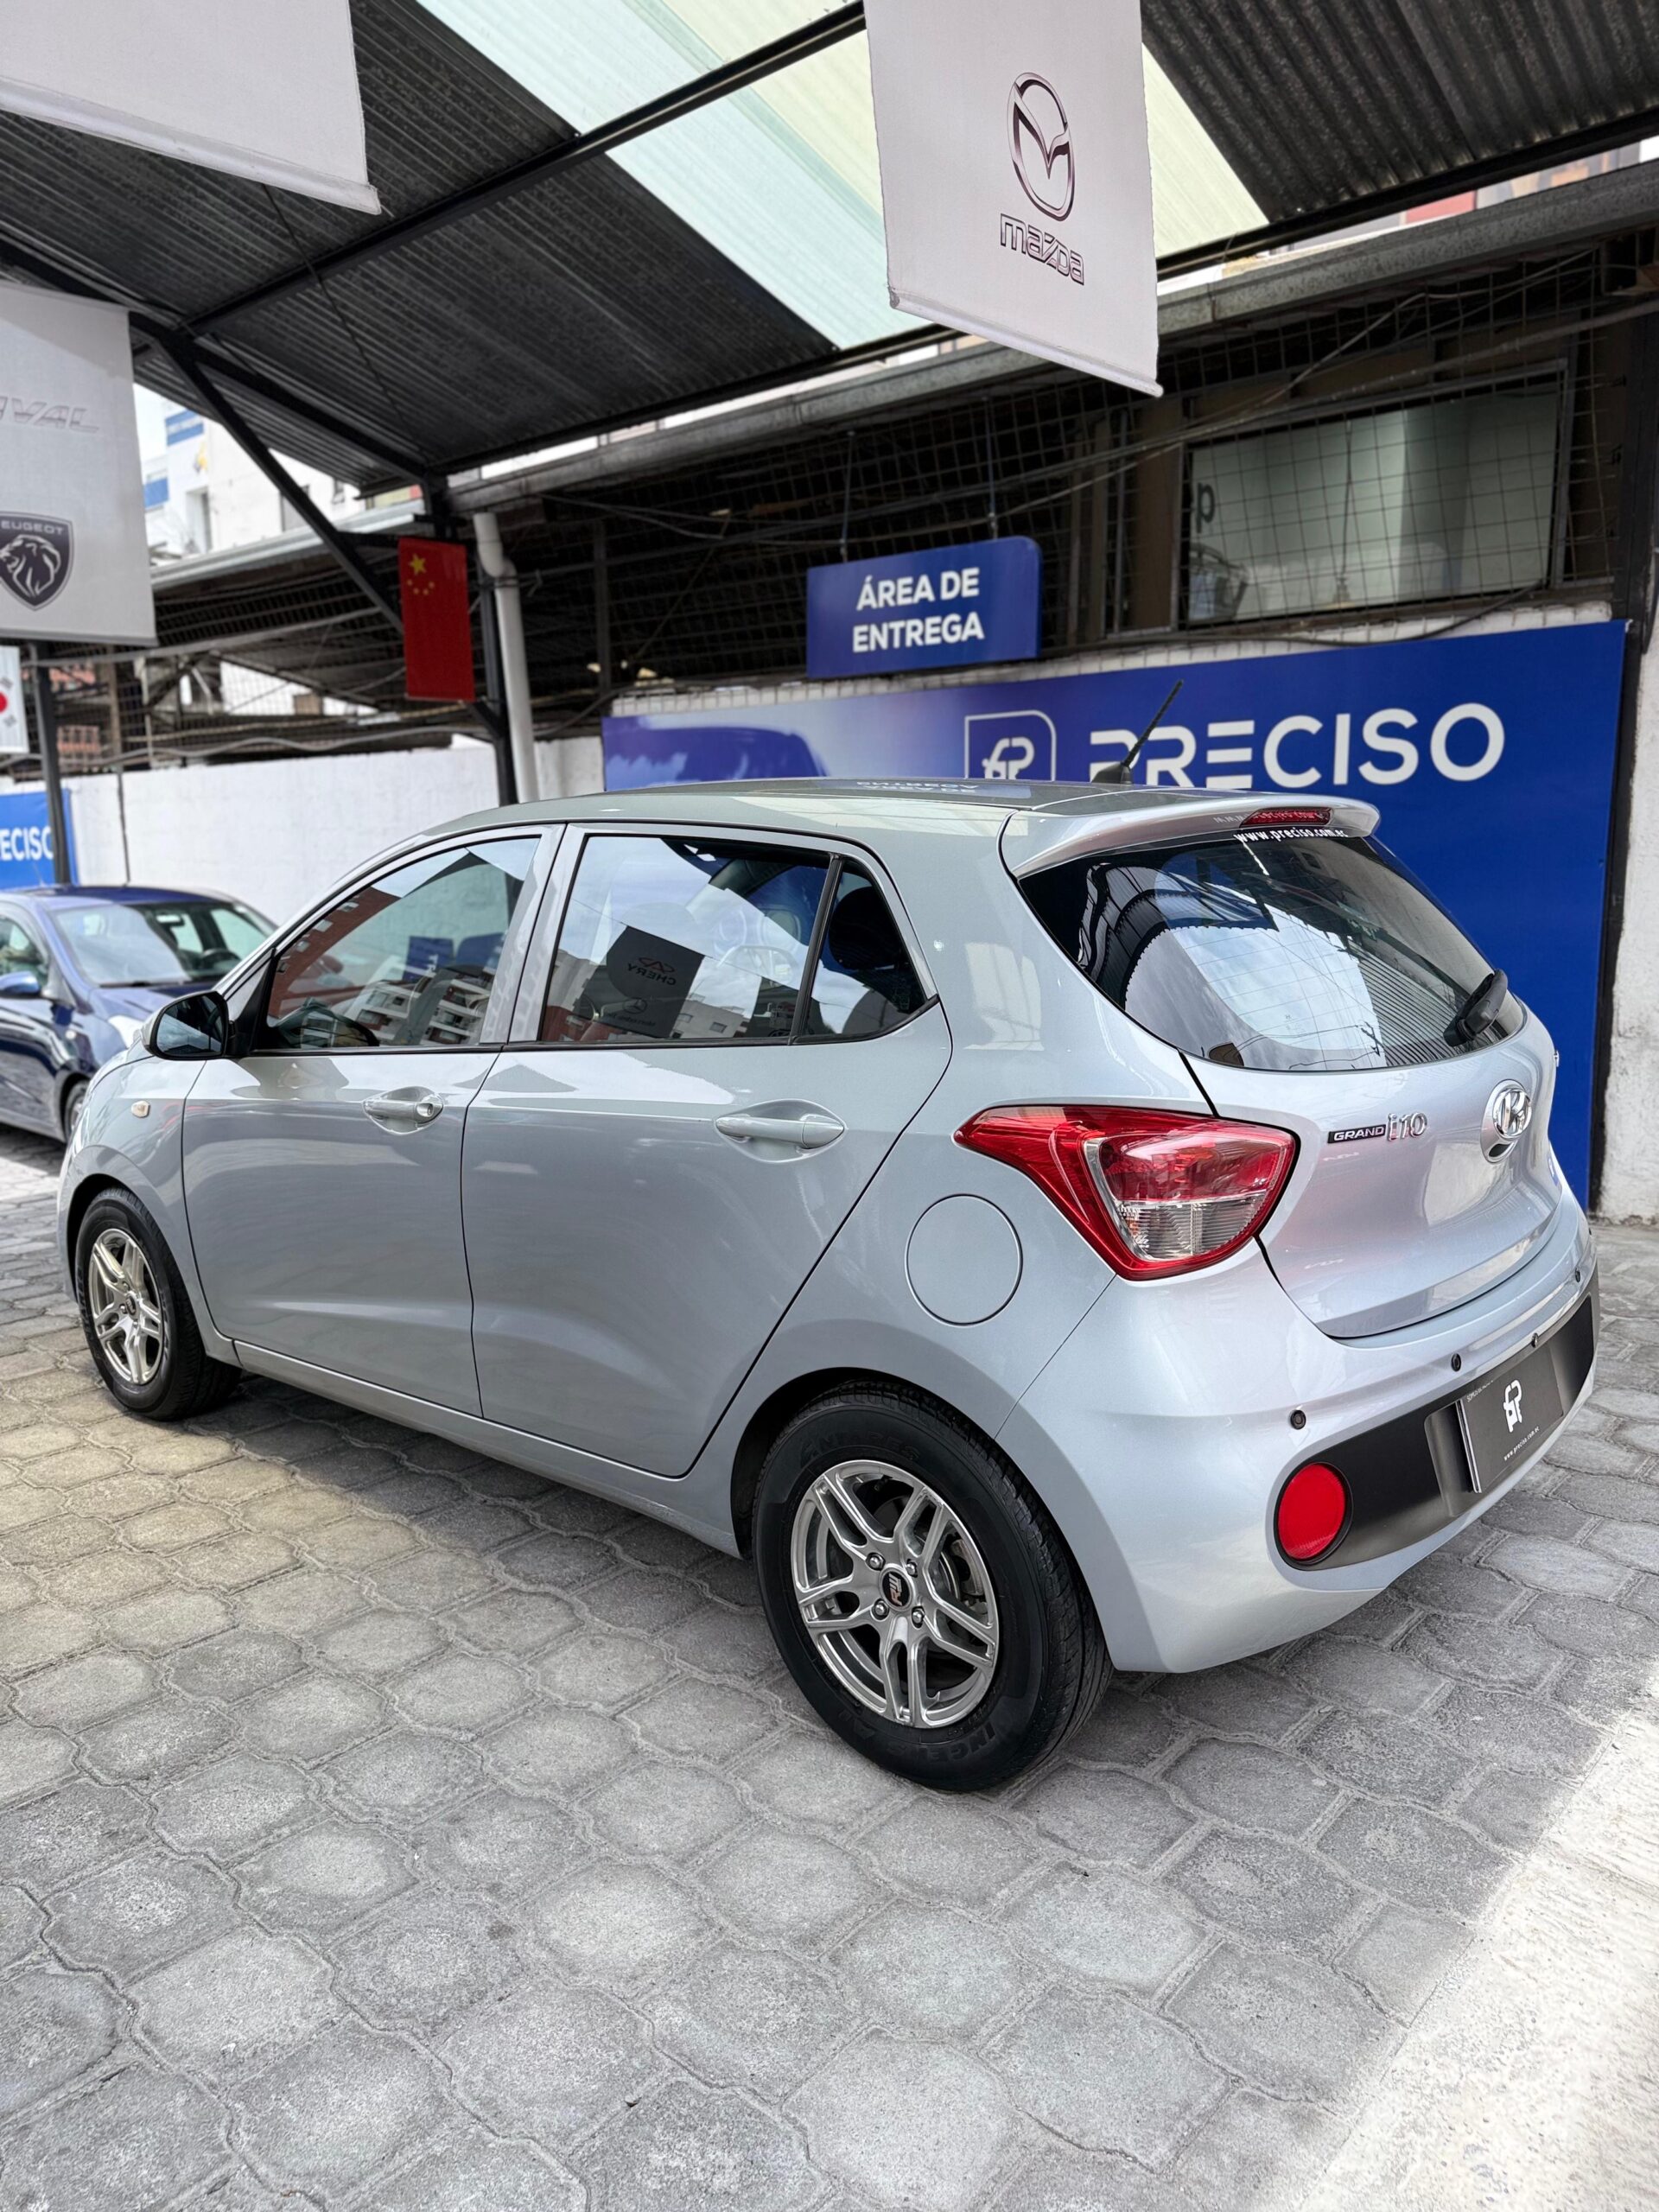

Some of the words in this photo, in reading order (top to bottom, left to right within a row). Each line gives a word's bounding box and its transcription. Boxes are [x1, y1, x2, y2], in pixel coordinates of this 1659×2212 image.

[0, 520, 64, 535] EUGEOT
[856, 575, 935, 610] ÁREA
[940, 567, 980, 600] DE
[853, 612, 985, 652] ENTREGA
[1090, 702, 1505, 788] PRECISO
[1233, 827, 1349, 842] www.preciso.com.ec
[1333, 1126, 1384, 1141] GRAND
[1387, 1112, 1428, 1141] i10
[799, 1429, 920, 1465] ANRES
